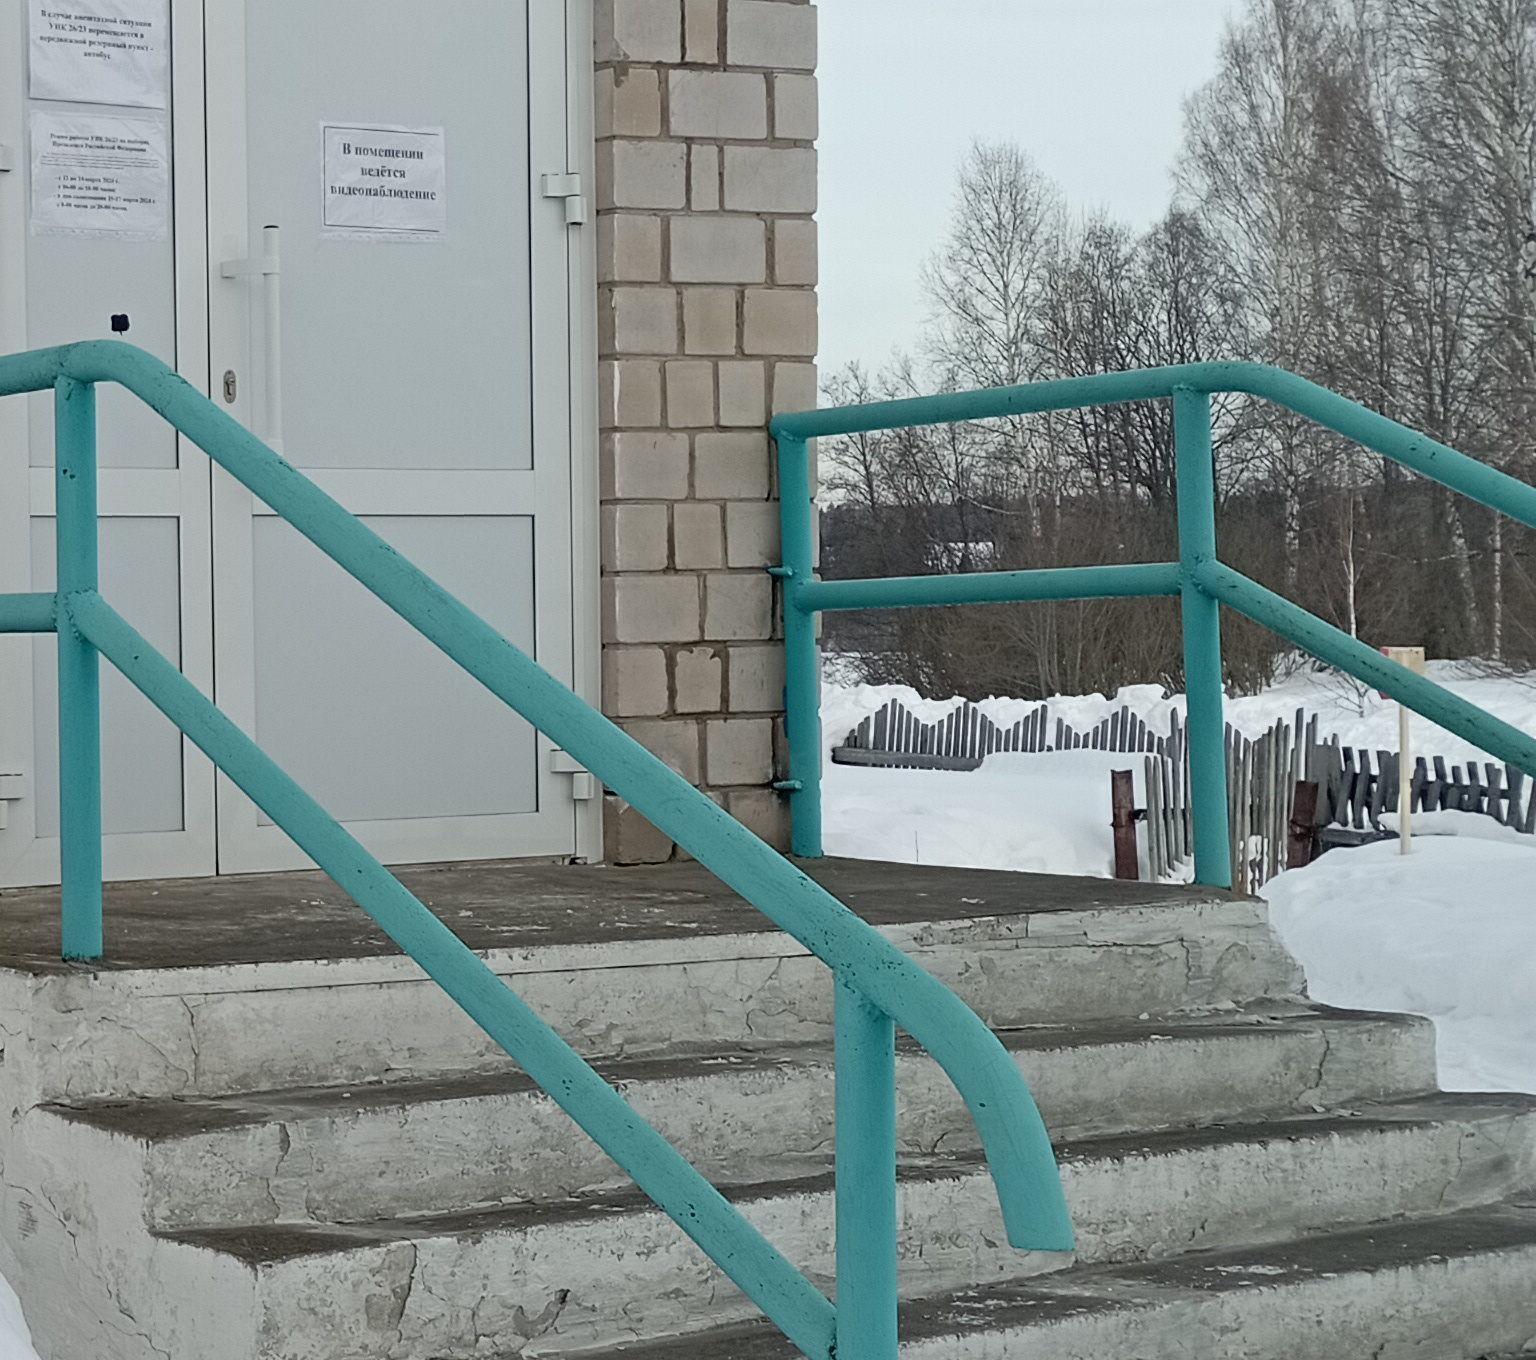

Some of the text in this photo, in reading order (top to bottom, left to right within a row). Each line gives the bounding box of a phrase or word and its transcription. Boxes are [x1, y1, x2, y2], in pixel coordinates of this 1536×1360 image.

[342, 142, 424, 159] В помещении
[360, 165, 406, 178] ведётся
[330, 185, 437, 200] видеонаблюдение
